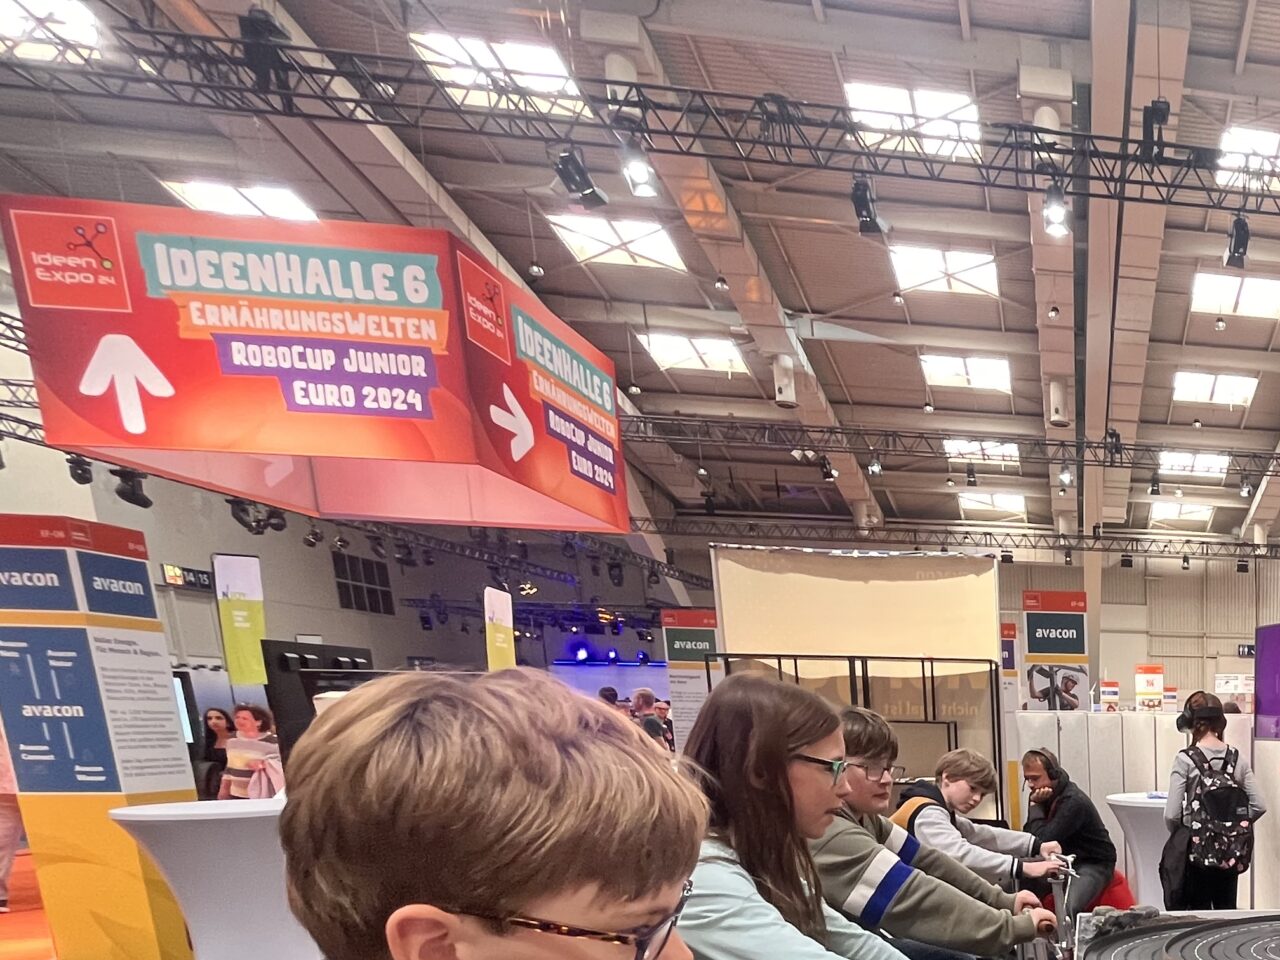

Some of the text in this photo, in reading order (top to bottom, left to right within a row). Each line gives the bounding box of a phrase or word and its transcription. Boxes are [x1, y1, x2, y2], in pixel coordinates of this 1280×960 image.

[30, 251, 98, 269] Ideen
[35, 267, 96, 285] Expo
[153, 242, 430, 304] IDEENHALLE 6
[188, 300, 438, 341] ERNÄHRUNGSWELTEN
[231, 341, 428, 378] ROBOCUP JUNIOR
[517, 315, 612, 411] IDEENHALLE 6
[292, 380, 423, 412] EURO 2024
[571, 450, 614, 490] EURO 2024
[0, 571, 60, 587] vacon
[92, 576, 144, 596] avacon
[1035, 628, 1077, 639] avacon
[673, 640, 710, 650] avacon
[22, 704, 85, 717] avacon
